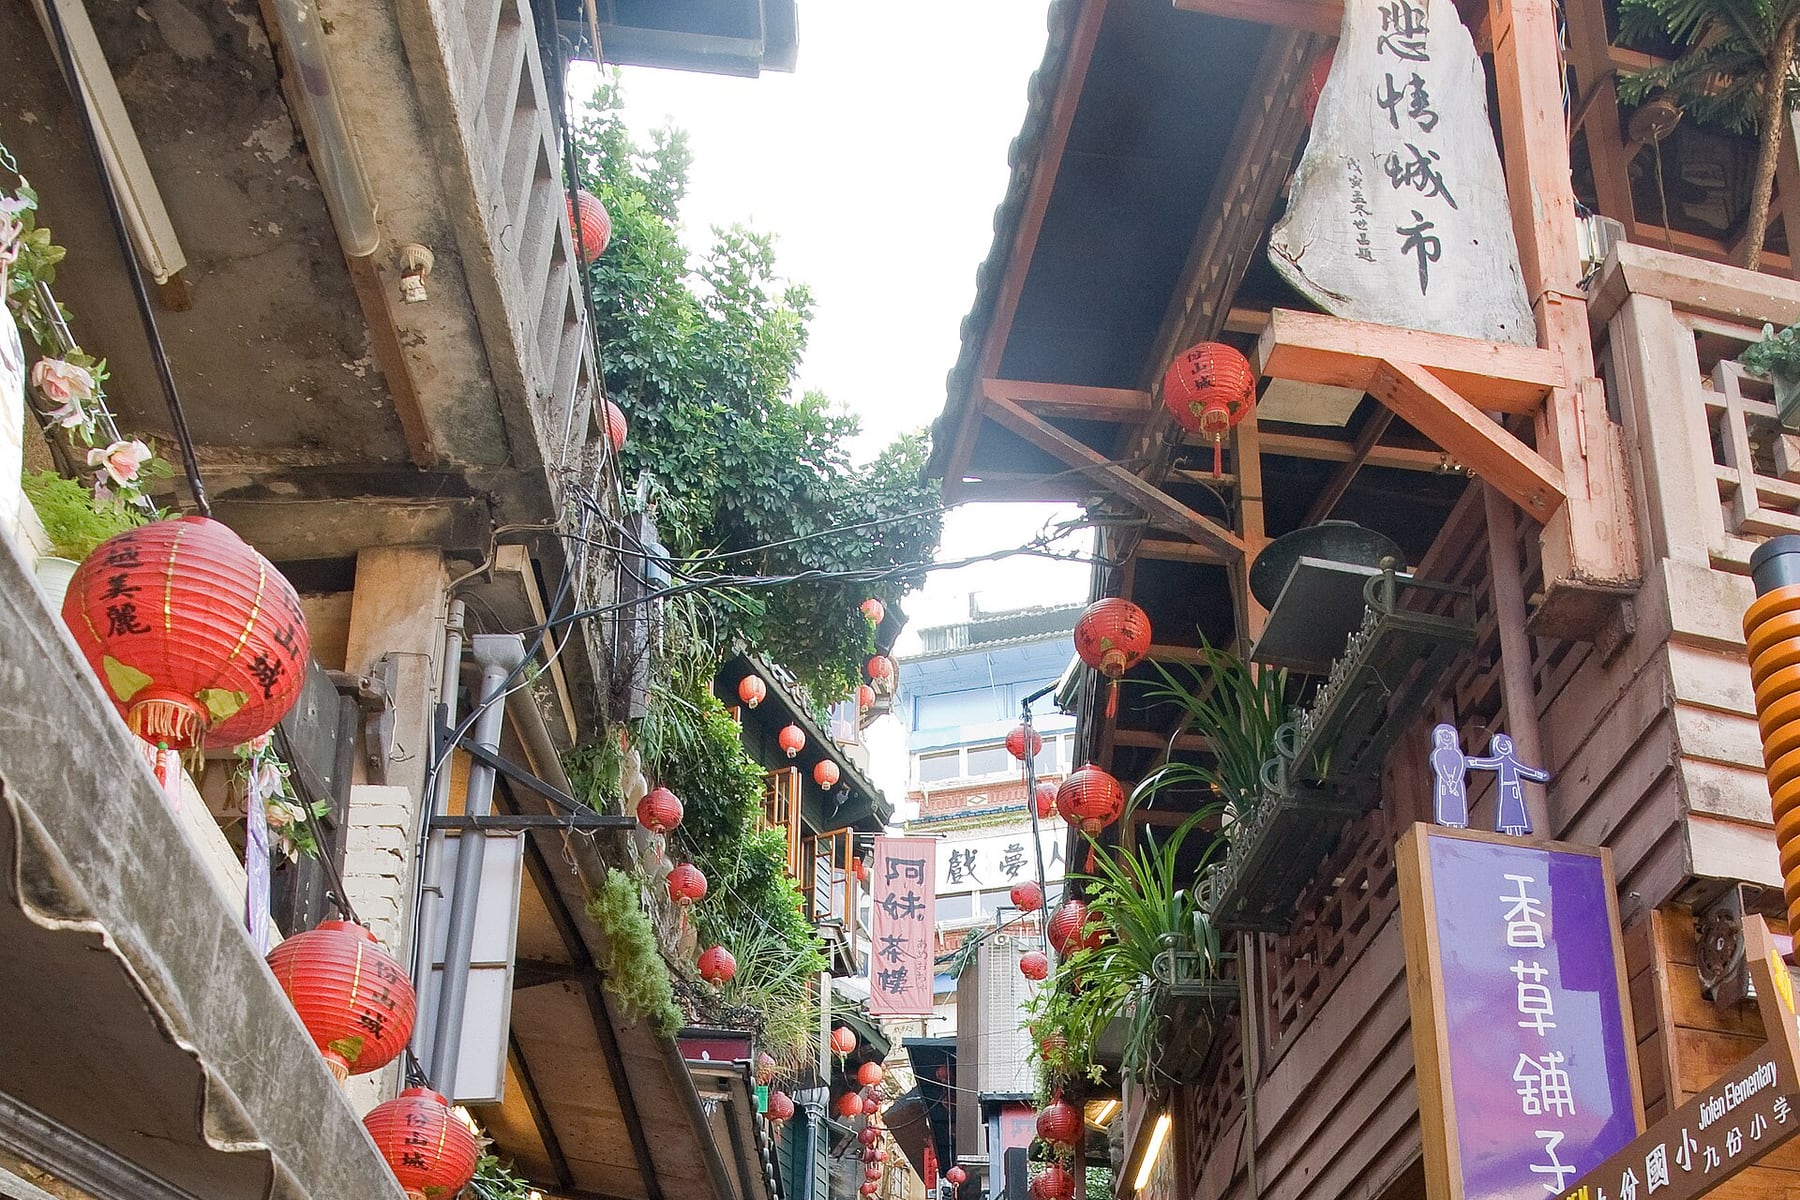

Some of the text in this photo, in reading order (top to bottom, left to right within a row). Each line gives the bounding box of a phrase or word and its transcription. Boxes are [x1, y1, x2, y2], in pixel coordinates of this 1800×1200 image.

[1377, 0, 1458, 297] 悲情城市
[877, 856, 926, 995] 阿妹茶樓
[1724, 1060, 1777, 1112] Elementary
[1596, 1128, 1698, 1200] 份國小
[1703, 1096, 1792, 1174] 九份小学
